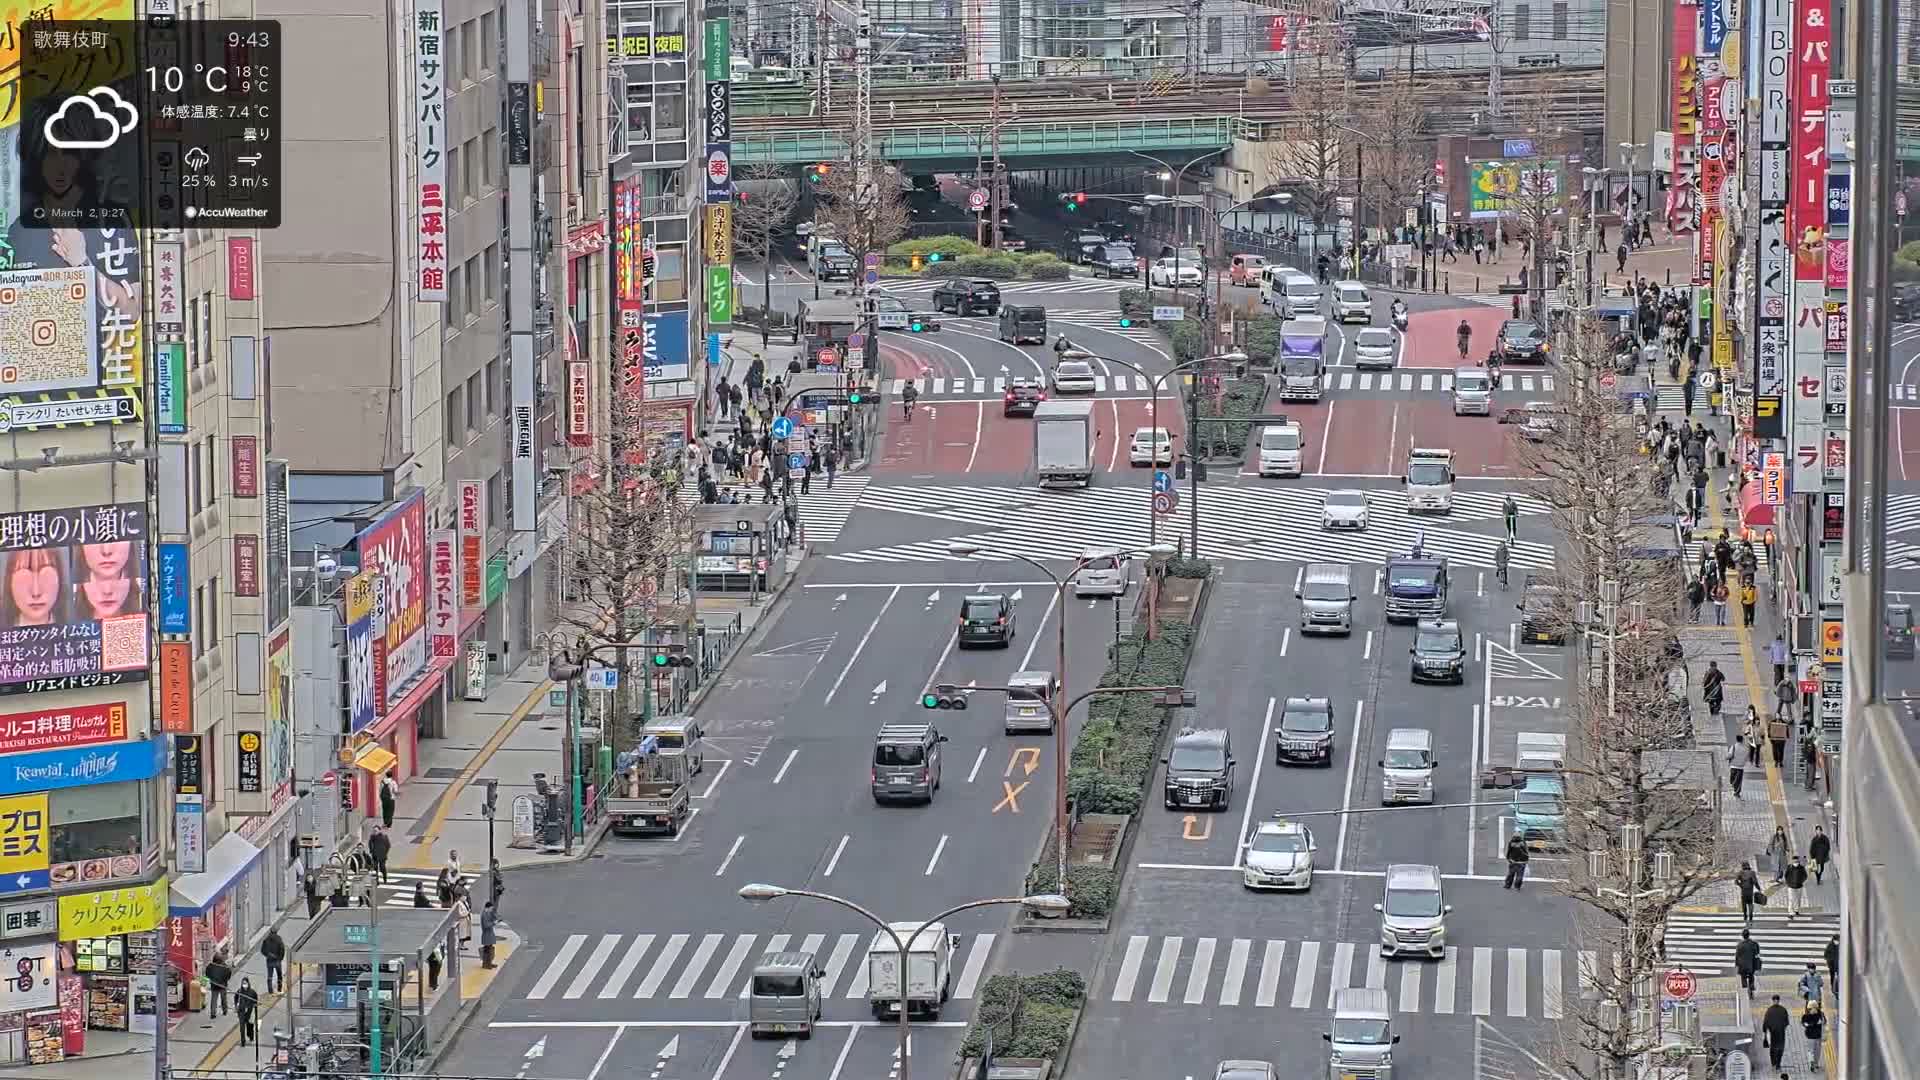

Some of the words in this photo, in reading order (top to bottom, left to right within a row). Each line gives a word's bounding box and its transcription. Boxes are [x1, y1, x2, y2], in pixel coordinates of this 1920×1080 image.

[655, 35, 684, 53] 夜間
[418, 10, 441, 169] 新宿サンパーク
[1708, 86, 1720, 119] アコム
[1675, 145, 1697, 233] エスパス
[421, 183, 445, 290] 三平本館
[712, 274, 727, 312] レイク
[1761, 328, 1776, 381] 大衆酒場
[158, 352, 170, 414] FamilyMart
[1797, 307, 1825, 469] パセラ
[15, 408, 51, 420] テンクリ
[55, 402, 113, 418] たいせい先生
[1831, 402, 1844, 413] 5F
[516, 406, 530, 459] HOMEGAME
[463, 486, 474, 530] GAME
[1829, 495, 1841, 505] 3F
[0, 506, 141, 549] 理想の小顔に
[715, 541, 728, 552] 10
[435, 541, 452, 629] 三平ストア
[376, 579, 384, 618] 389
[1, 622, 100, 646] ほぼダウンタイムなし
[0, 638, 101, 663] 固定バンドも不要
[0, 655, 101, 680] 革命的な脂肪吸引
[26, 673, 122, 693] リアエイドビジョン
[111, 710, 121, 734] 5F
[27, 733, 71, 746] RESTAURANT
[2, 810, 42, 835] プロ
[3, 835, 42, 857] ミス
[6, 910, 42, 931] 囲碁
[72, 902, 144, 926] クリスタル
[330, 990, 344, 1004] 12
